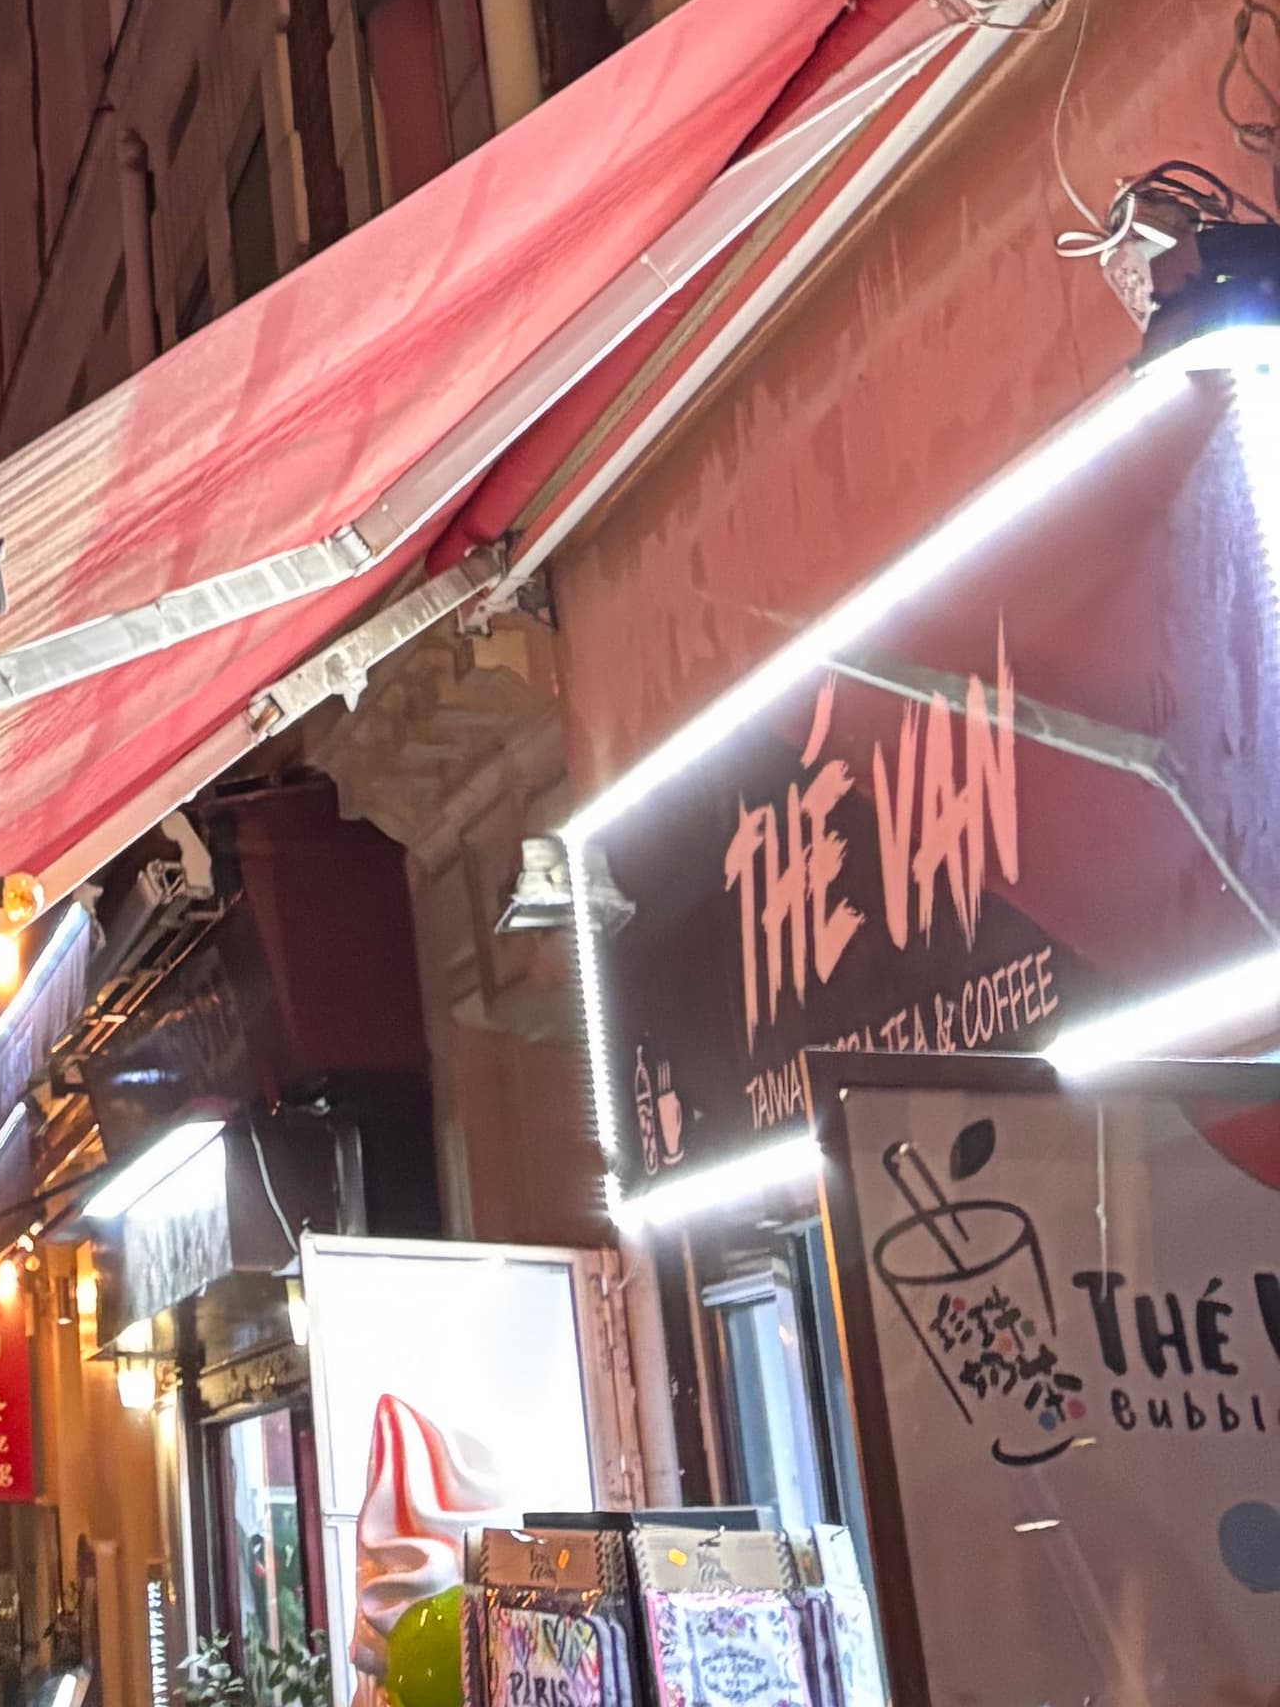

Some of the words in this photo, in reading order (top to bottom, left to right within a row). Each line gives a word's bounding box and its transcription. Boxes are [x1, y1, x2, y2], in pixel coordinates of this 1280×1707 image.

[725, 670, 866, 1058] THÉ
[873, 604, 1020, 953] VAN
[746, 1059, 806, 1130] TAIWA
[962, 945, 1059, 1049] COFFEE
[1111, 1389, 1280, 1433] Bubbl
